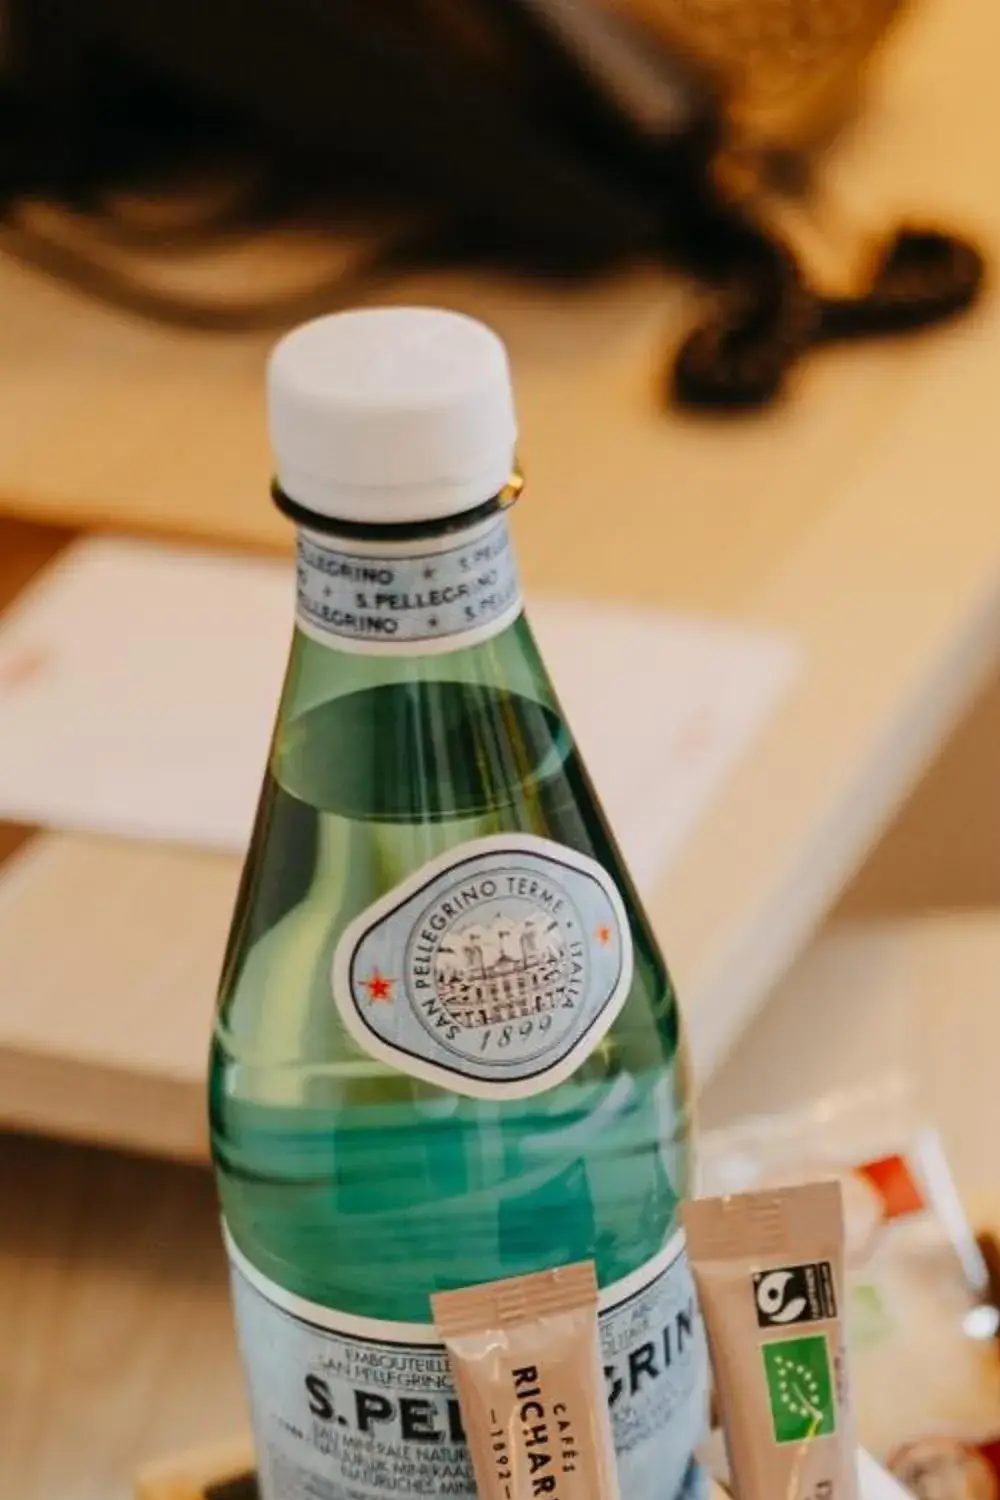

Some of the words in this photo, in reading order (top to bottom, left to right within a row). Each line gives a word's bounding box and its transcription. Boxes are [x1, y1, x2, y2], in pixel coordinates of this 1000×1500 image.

[506, 876, 564, 915] TERME
[415, 880, 497, 990] PELLEGRINO
[422, 999, 462, 1041] SAN
[553, 1402, 580, 1473] CAFÉS
